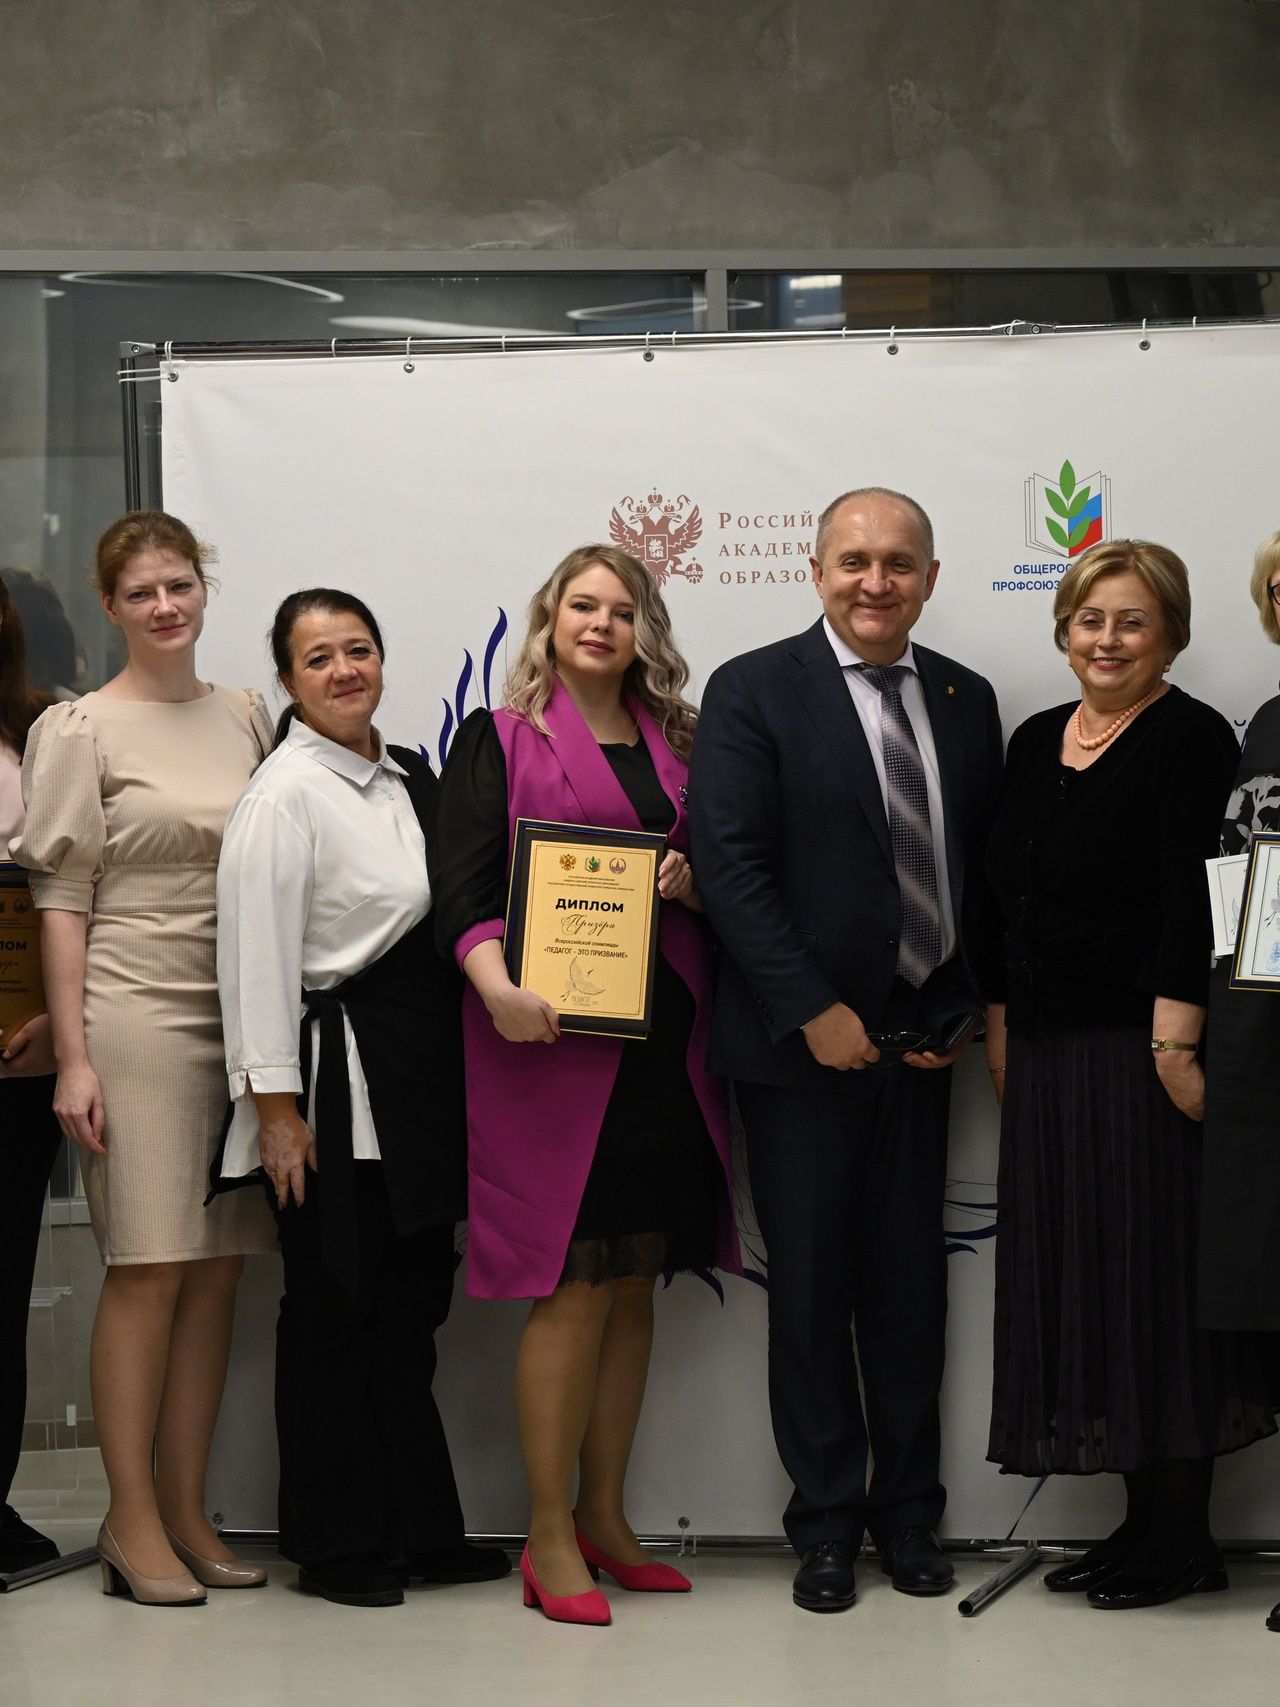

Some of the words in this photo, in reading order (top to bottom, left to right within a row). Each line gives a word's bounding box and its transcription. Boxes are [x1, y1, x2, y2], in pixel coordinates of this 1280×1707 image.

[718, 510, 821, 529] РОССИЙ
[718, 541, 811, 558] АКАДЕМ
[719, 569, 815, 585] ОБРАЗО
[1013, 563, 1073, 576] ОБЩЕРОС
[555, 898, 624, 913] ДИПЛОМ
[560, 913, 616, 937] Призёра
[554, 937, 591, 947] Всероссийской
[592, 941, 619, 949] олимпиады
[577, 948, 590, 956] ЭТО
